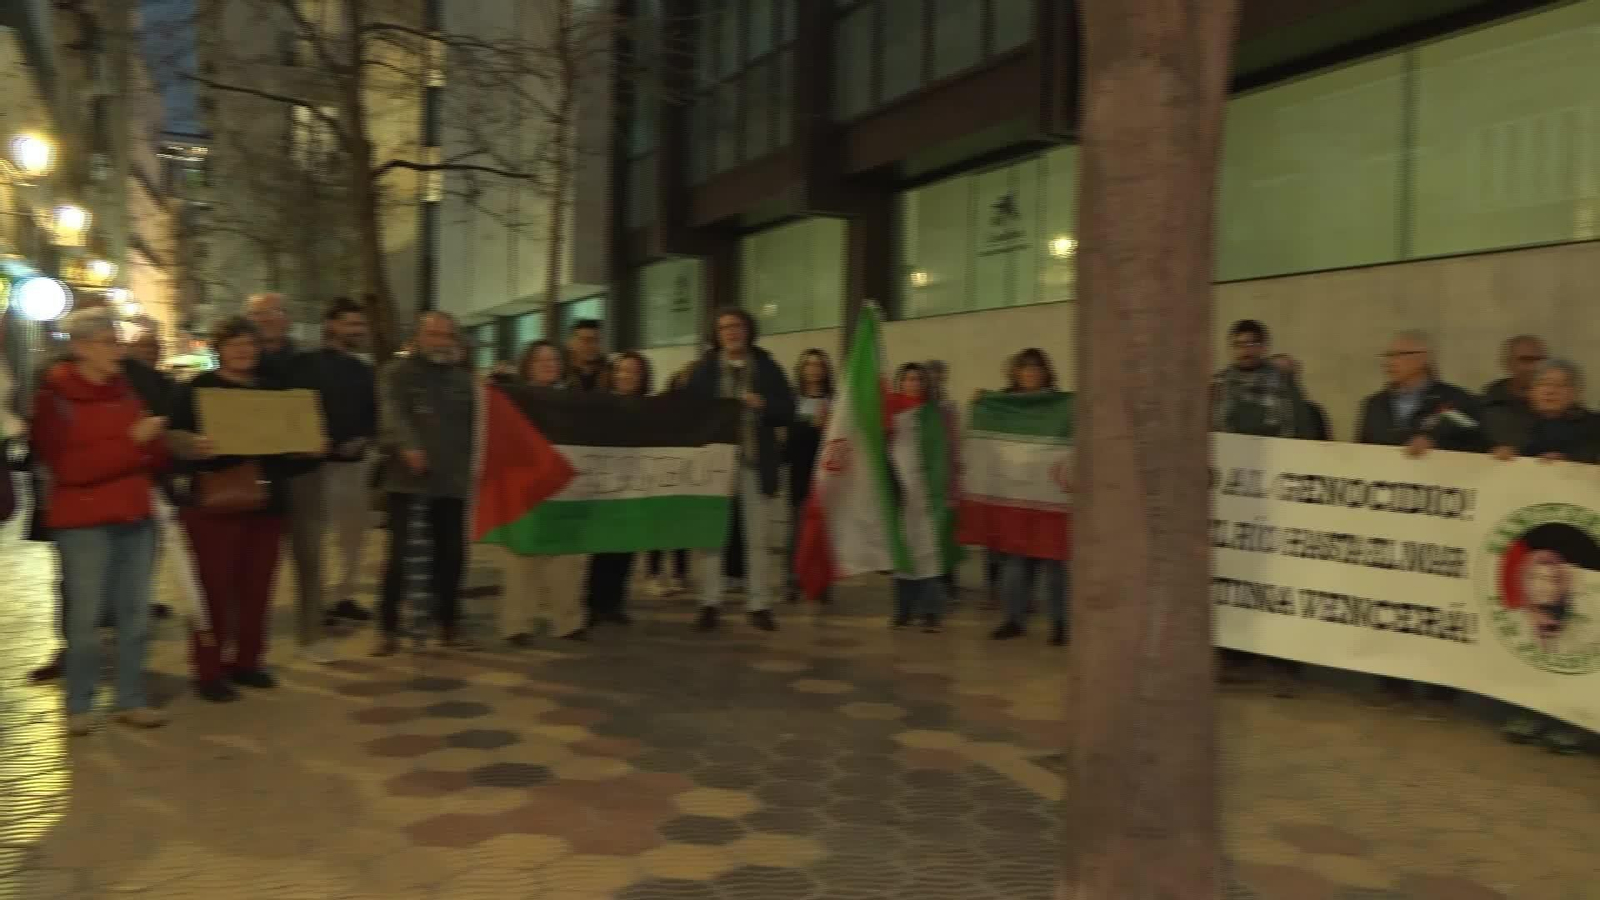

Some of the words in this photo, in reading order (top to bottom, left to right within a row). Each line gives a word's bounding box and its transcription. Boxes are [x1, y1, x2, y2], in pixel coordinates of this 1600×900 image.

[1221, 467, 1268, 499] AL
[1276, 472, 1478, 520] GENOCIDIO!
[1210, 576, 1297, 617] TINA
[1297, 587, 1479, 645] VENCERÁ!
